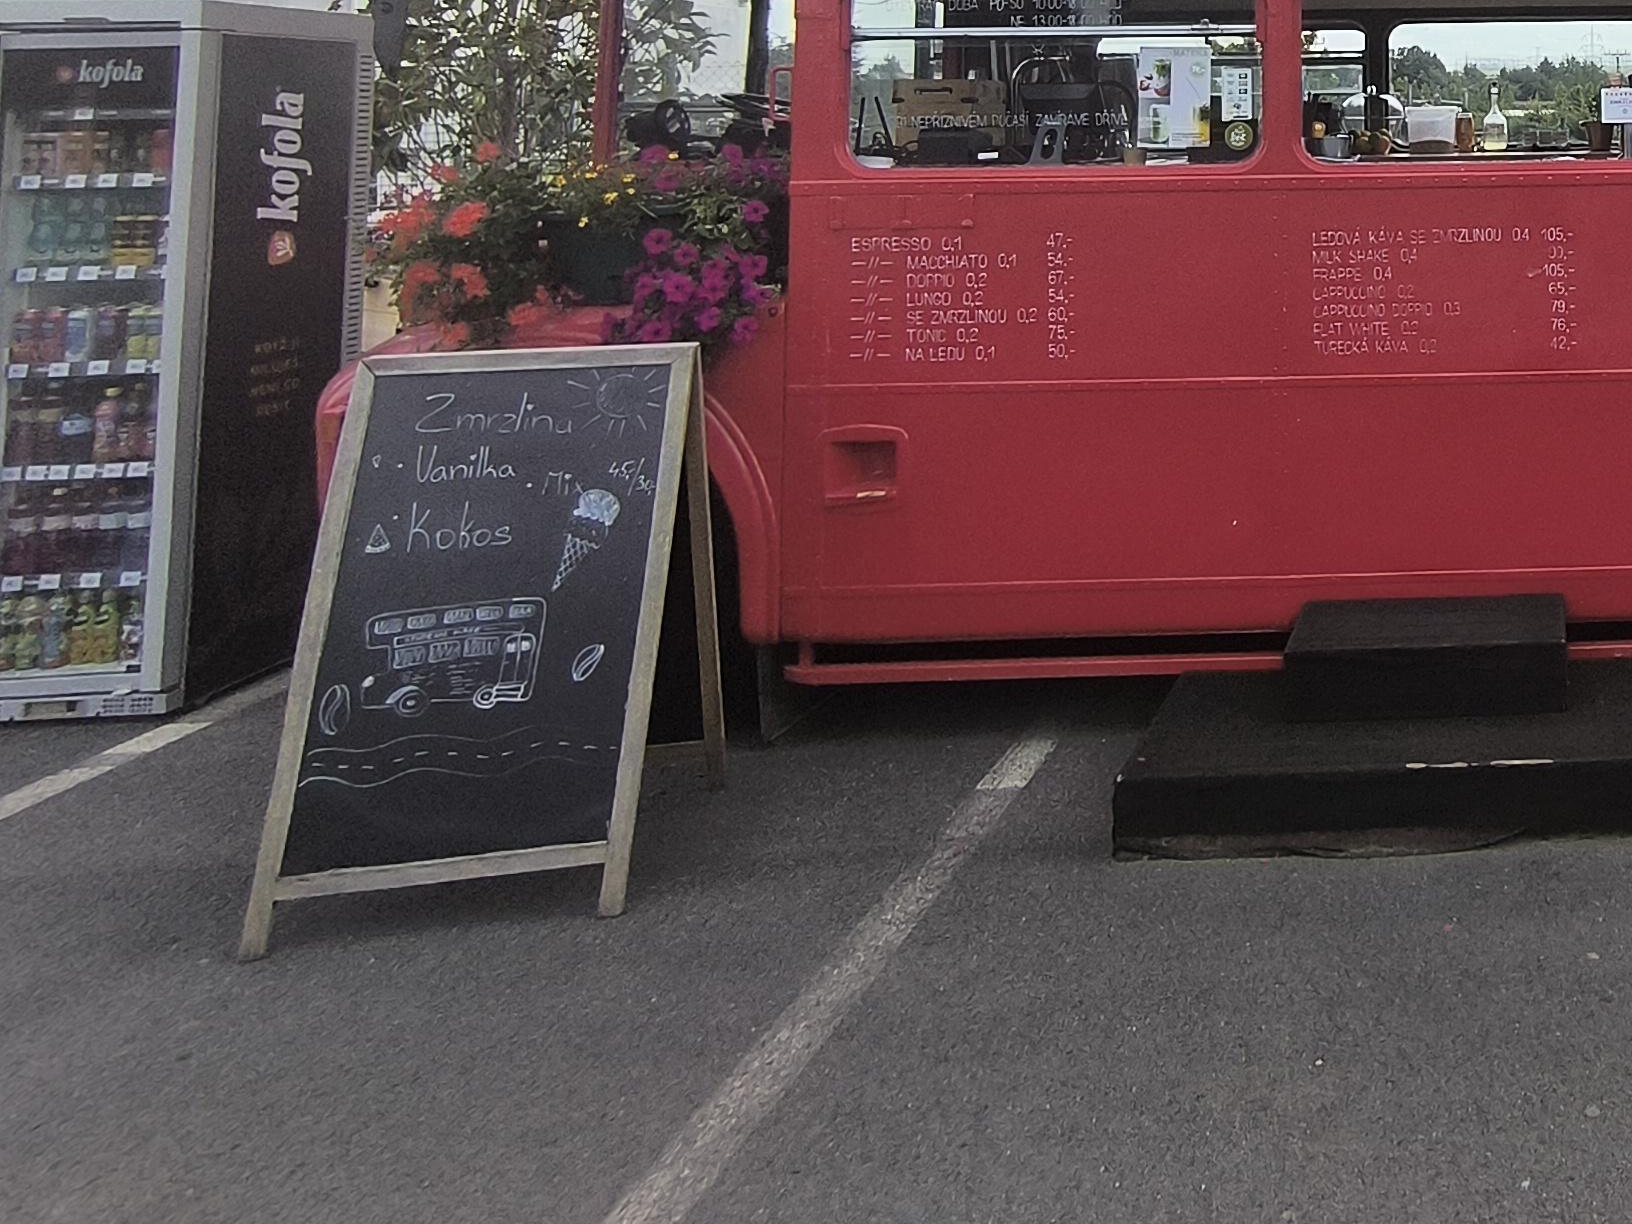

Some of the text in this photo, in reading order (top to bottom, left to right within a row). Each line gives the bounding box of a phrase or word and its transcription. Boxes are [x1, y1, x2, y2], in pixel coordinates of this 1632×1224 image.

[78, 59, 144, 88] kofola
[256, 91, 313, 223] kofola
[851, 235, 931, 253] ESPRESSO
[906, 253, 988, 269] MACCHIATO
[1349, 248, 1390, 264] SHAKE
[906, 272, 955, 288] DOPPIO
[906, 292, 951, 307] LUNGO
[906, 310, 923, 325] SE
[930, 308, 1007, 325] ZMRZLINOU
[906, 328, 947, 344] TONIC
[1375, 335, 1409, 354] KÁVA
[905, 347, 924, 361] NA
[929, 346, 965, 361] LEDU
[417, 445, 516, 483] Vanilka
[541, 471, 584, 496] Mix
[407, 501, 513, 553] Kokos
